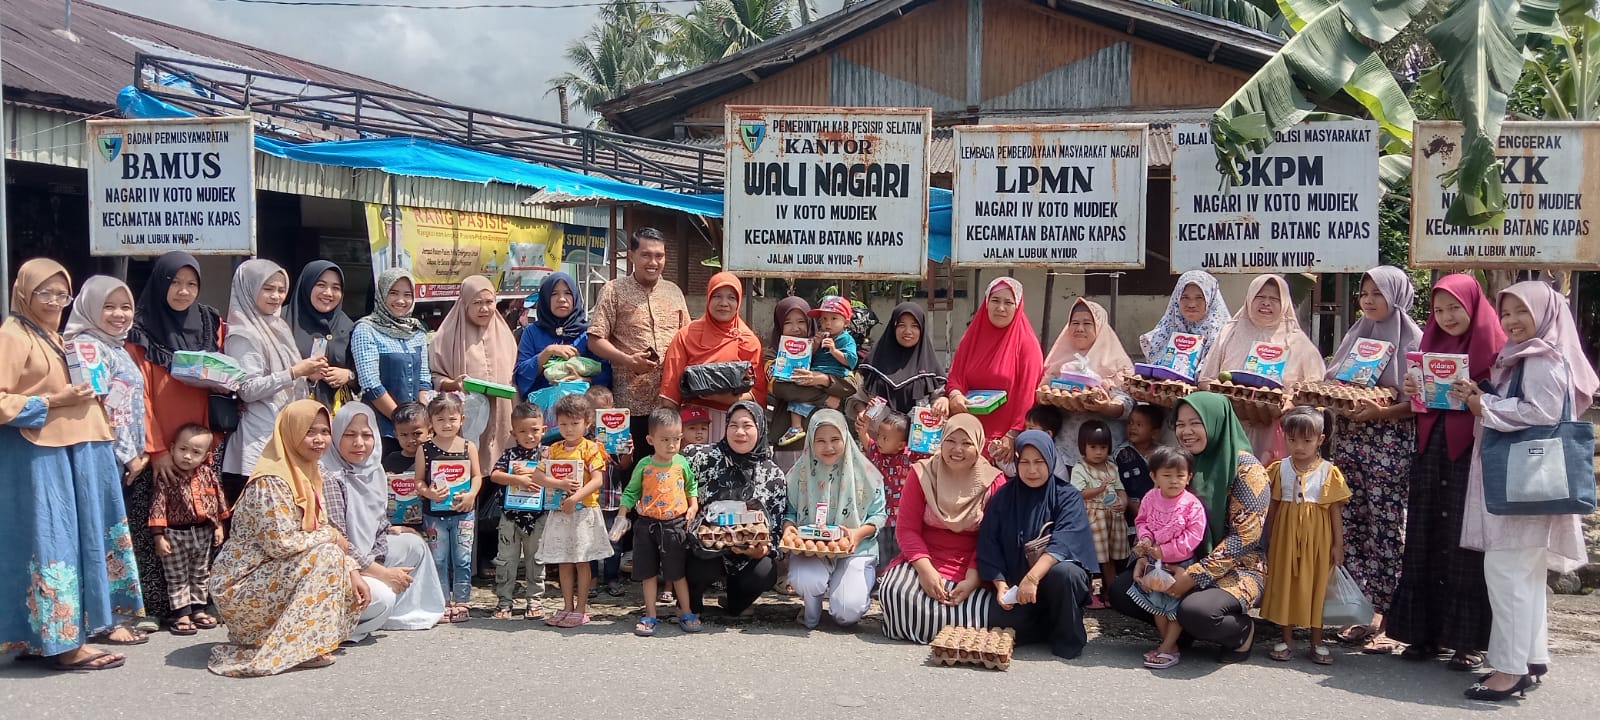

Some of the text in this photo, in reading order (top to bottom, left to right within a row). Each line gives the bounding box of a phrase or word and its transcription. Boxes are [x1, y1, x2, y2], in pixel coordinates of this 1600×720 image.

[772, 119, 829, 133] PEMERINTAH
[852, 120, 884, 134] PESISIR
[886, 121, 922, 135] SELATAN
[127, 131, 229, 145] BADAN PERMUSYAWARATAN
[1178, 131, 1208, 146] BALAI
[1275, 129, 1300, 144] OLISI
[1304, 129, 1371, 143] MASYARAKAT
[1497, 135, 1562, 149] ENGGERAK
[784, 138, 873, 155] KANTOR
[961, 145, 1139, 160] LEMBAGA PEMBERDAYAAN MASYARAKAT NAGARI
[121, 151, 222, 180] BAMUS
[1230, 155, 1324, 187] BKPM
[744, 162, 910, 198] WALI NAGARI
[995, 165, 1095, 194] LPMN
[105, 186, 236, 203] NAGARI IV KOTO MUDIEK
[1193, 192, 1359, 213] NAGARI IV KOTO MUDIEK
[1538, 193, 1582, 210] MUDIEK
[413, 207, 455, 225] RANG
[776, 204, 877, 221] IV KOTO MUDIEK
[975, 201, 1118, 218] NAGARI IV KOTO MUDIEK
[102, 210, 241, 227] KECAMATAN BATANG KAPAS
[966, 225, 1127, 242] KECAMATAN BATANG KAPAS
[1178, 221, 1370, 241] KECAMATAN BATANG KAPAS
[1503, 219, 1549, 236] BATANG
[1552, 219, 1590, 236] KAPAS
[121, 233, 145, 245] JALAN
[147, 233, 170, 244] LUBUK
[744, 229, 904, 247] KECAMATAN BATANG KAPAS
[767, 253, 794, 265] JALAN
[797, 253, 825, 265] LUBUK
[983, 247, 1078, 259] JALAN LUBUK NYIUR
[1447, 245, 1475, 257] JALAN
[1478, 245, 1507, 257] LUBUK
[1201, 252, 1237, 268] JALAN
[1242, 252, 1278, 267] LUBUK
